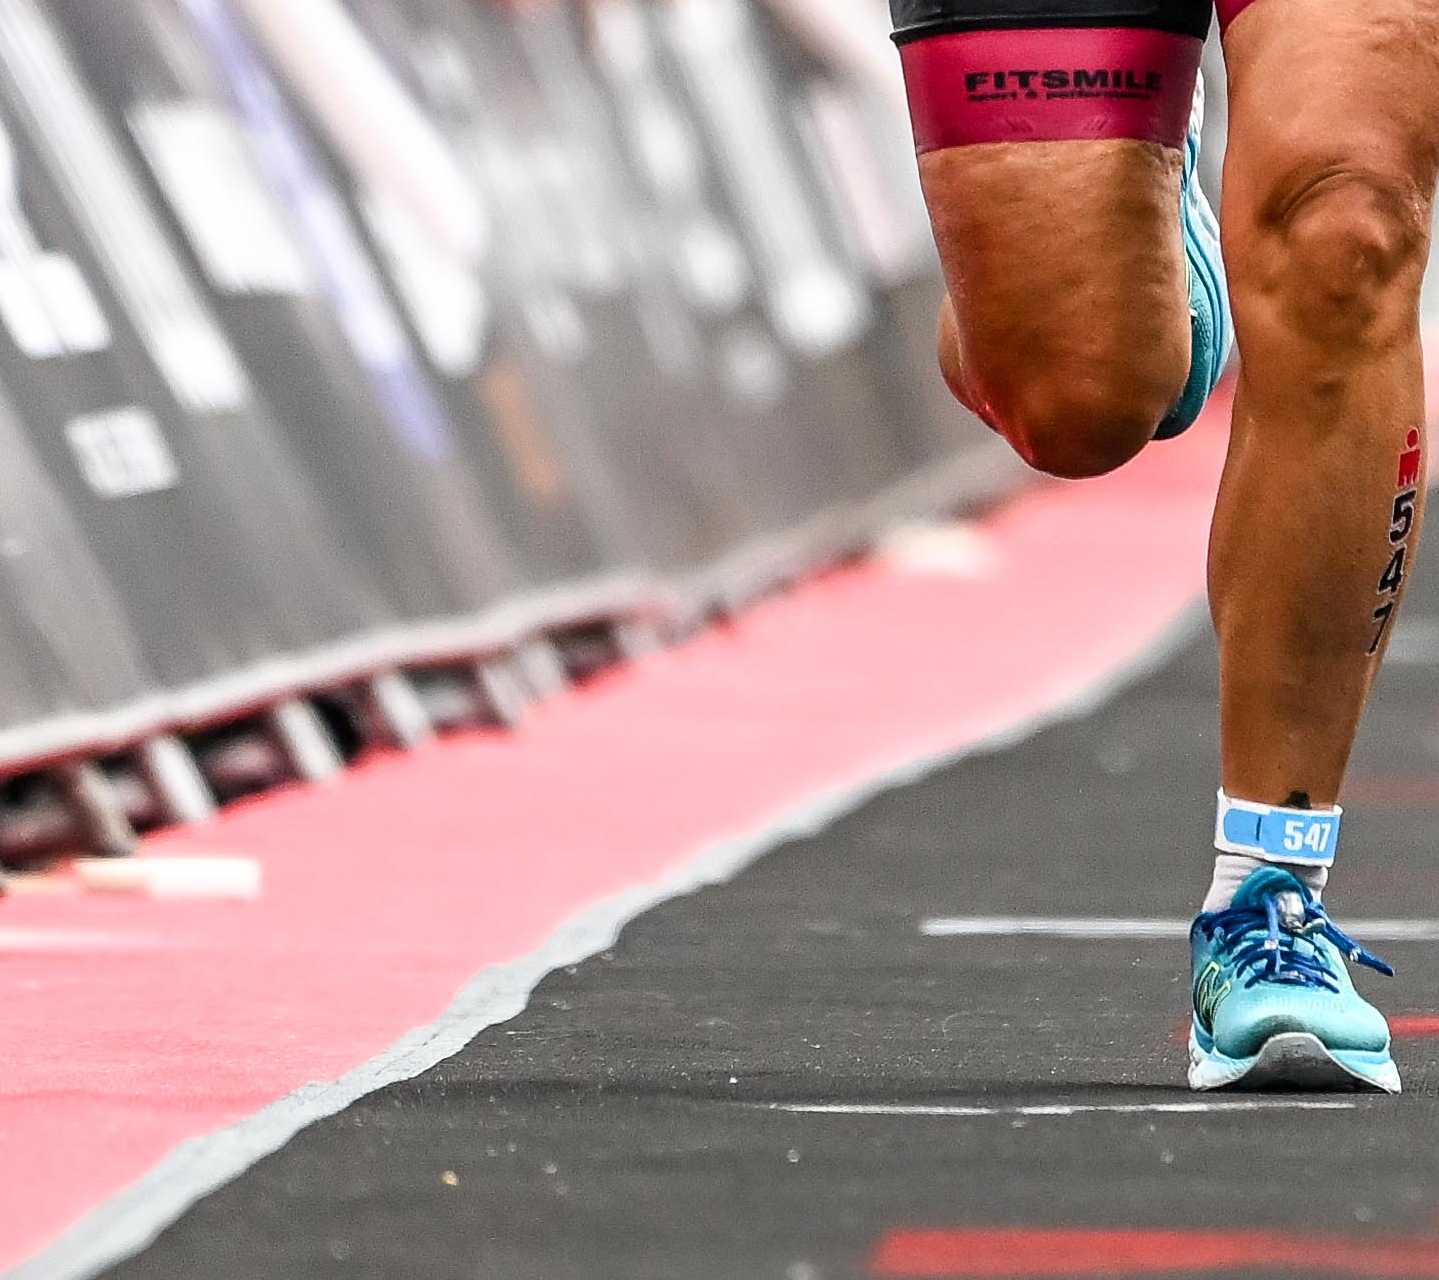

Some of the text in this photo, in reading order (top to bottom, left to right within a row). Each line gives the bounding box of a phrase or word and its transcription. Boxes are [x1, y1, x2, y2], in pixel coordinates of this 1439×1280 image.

[964, 68, 1163, 91] FITSMILE
[1365, 488, 1418, 657] 547
[1283, 819, 1332, 852] 547
